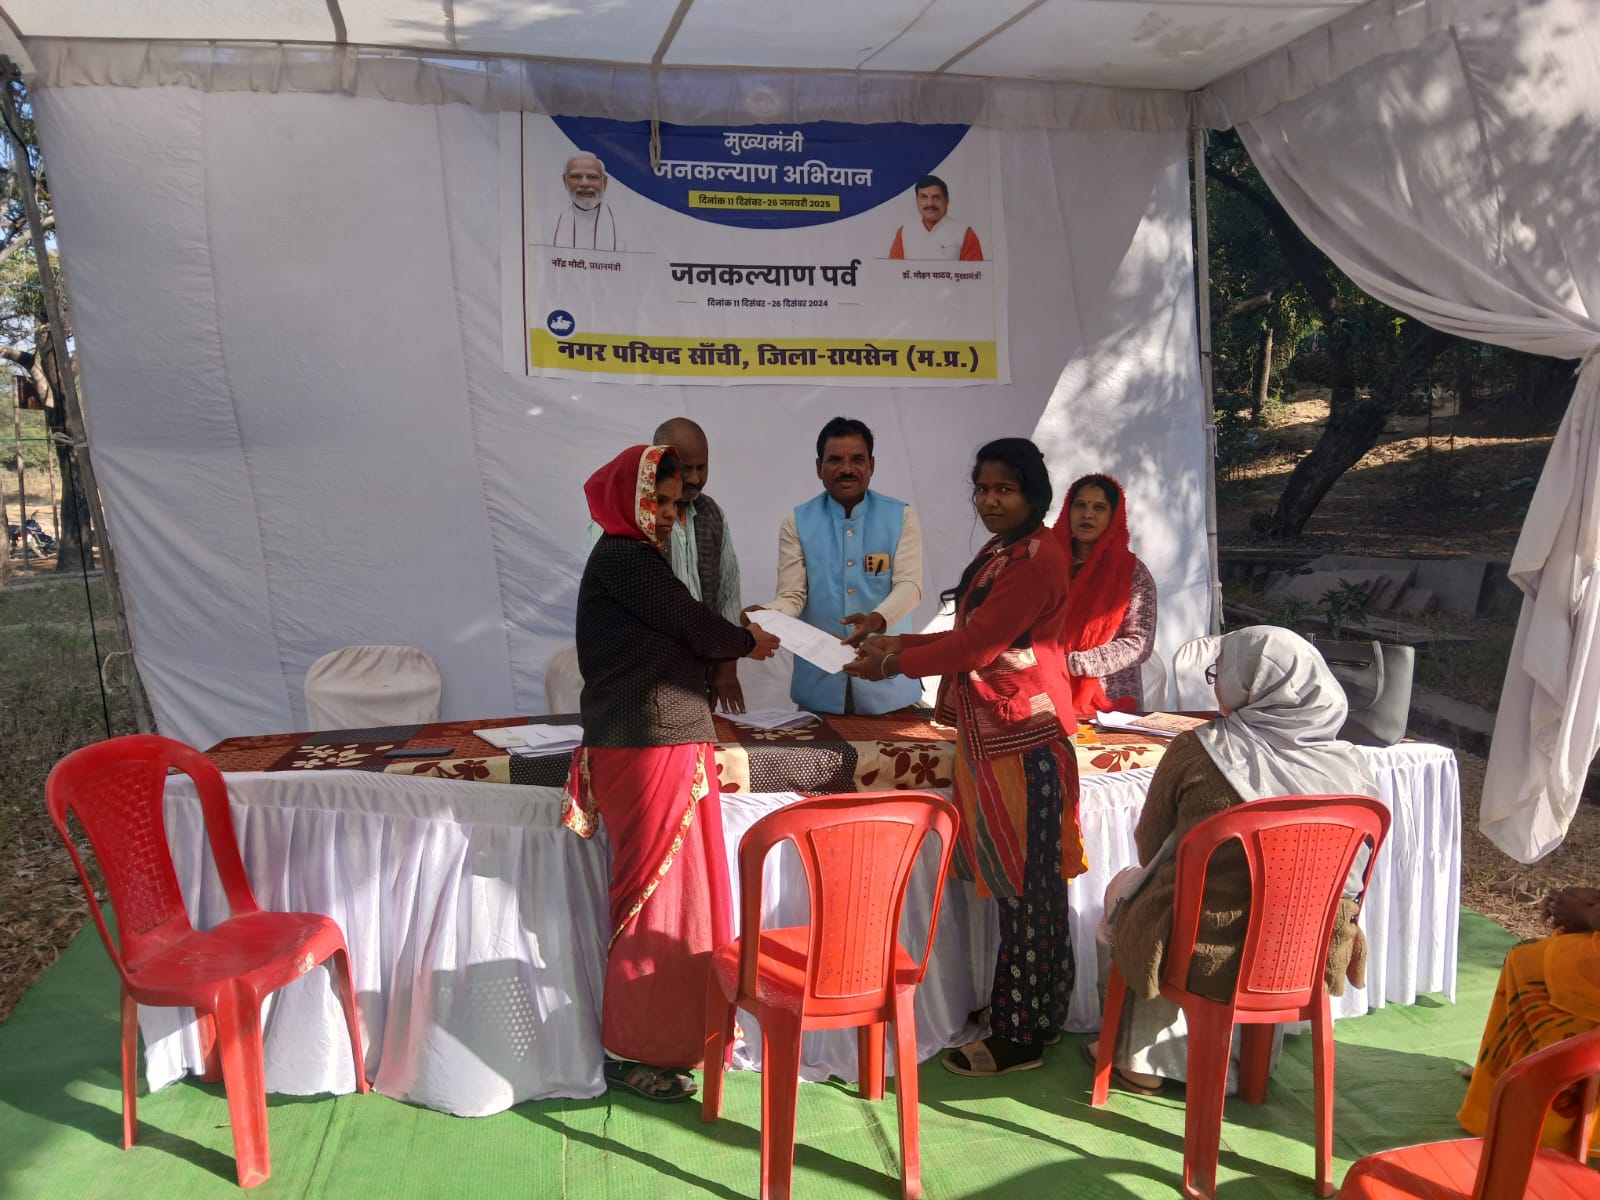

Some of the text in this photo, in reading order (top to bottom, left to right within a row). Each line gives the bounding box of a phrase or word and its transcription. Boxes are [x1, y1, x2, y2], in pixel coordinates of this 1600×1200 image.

[723, 131, 804, 156] मुख्यमंत्री
[653, 159, 873, 187] जनकल्याण अभियान
[699, 194, 726, 206] दिनांक
[727, 198, 734, 206] 11
[779, 197, 808, 208] जनवरी
[809, 200, 831, 208] 2025
[568, 259, 587, 270] मोदी,
[589, 262, 621, 272] प्रधानमंत्री
[670, 259, 862, 287] जनकल्याण पर्व
[913, 270, 931, 280] मोहन
[932, 271, 953, 280] यादव,
[707, 297, 732, 307] दिनांक
[733, 299, 740, 307] 11
[782, 297, 807, 307] दिसंबर
[808, 299, 829, 307] 2024
[557, 341, 607, 361] नगर
[612, 341, 682, 364] परिषद
[757, 344, 899, 366] जिला-रायसेन
[907, 345, 979, 372] (म.प्र.)
